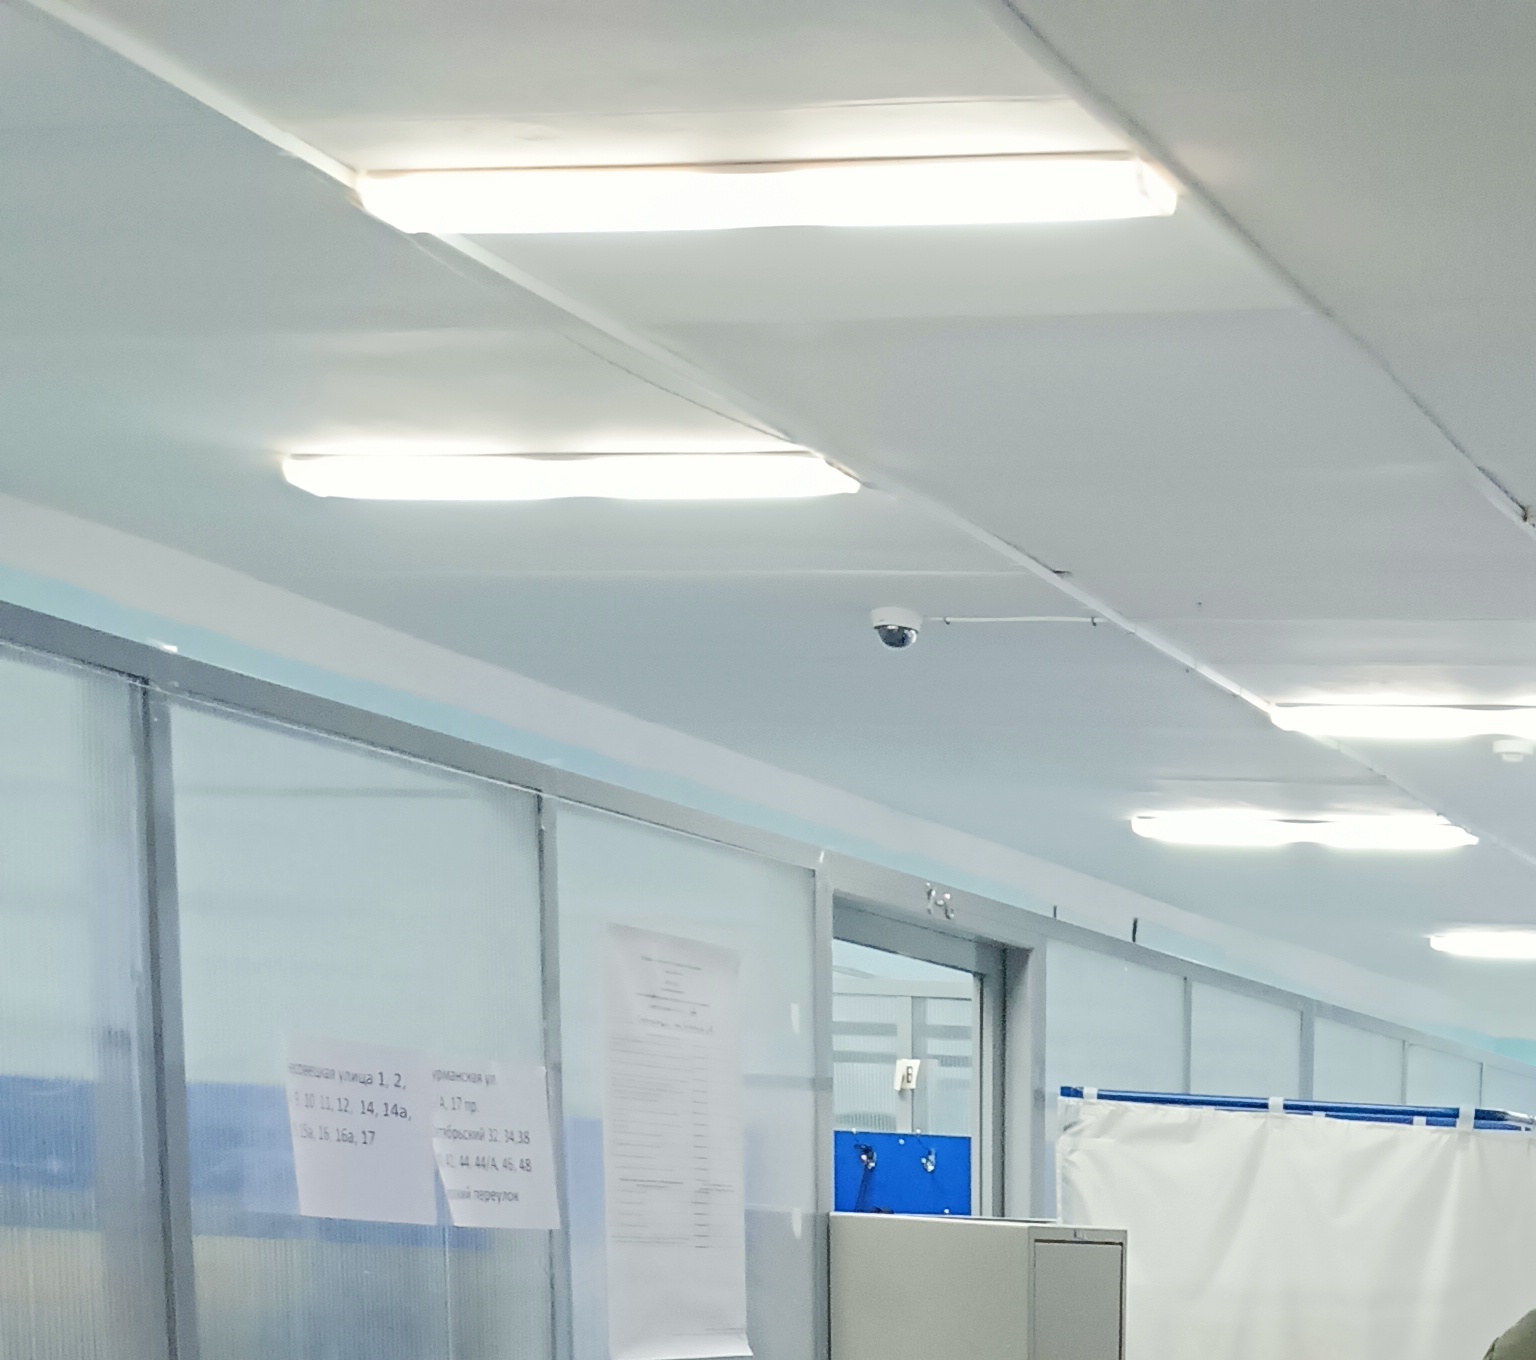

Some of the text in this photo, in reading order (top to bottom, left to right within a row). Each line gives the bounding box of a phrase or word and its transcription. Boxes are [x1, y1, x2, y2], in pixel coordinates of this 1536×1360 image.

[394, 1072, 406, 1090] 2,
[360, 1099, 379, 1118] 14,
[383, 1101, 411, 1121] 14а,
[361, 1130, 376, 1145] 17
